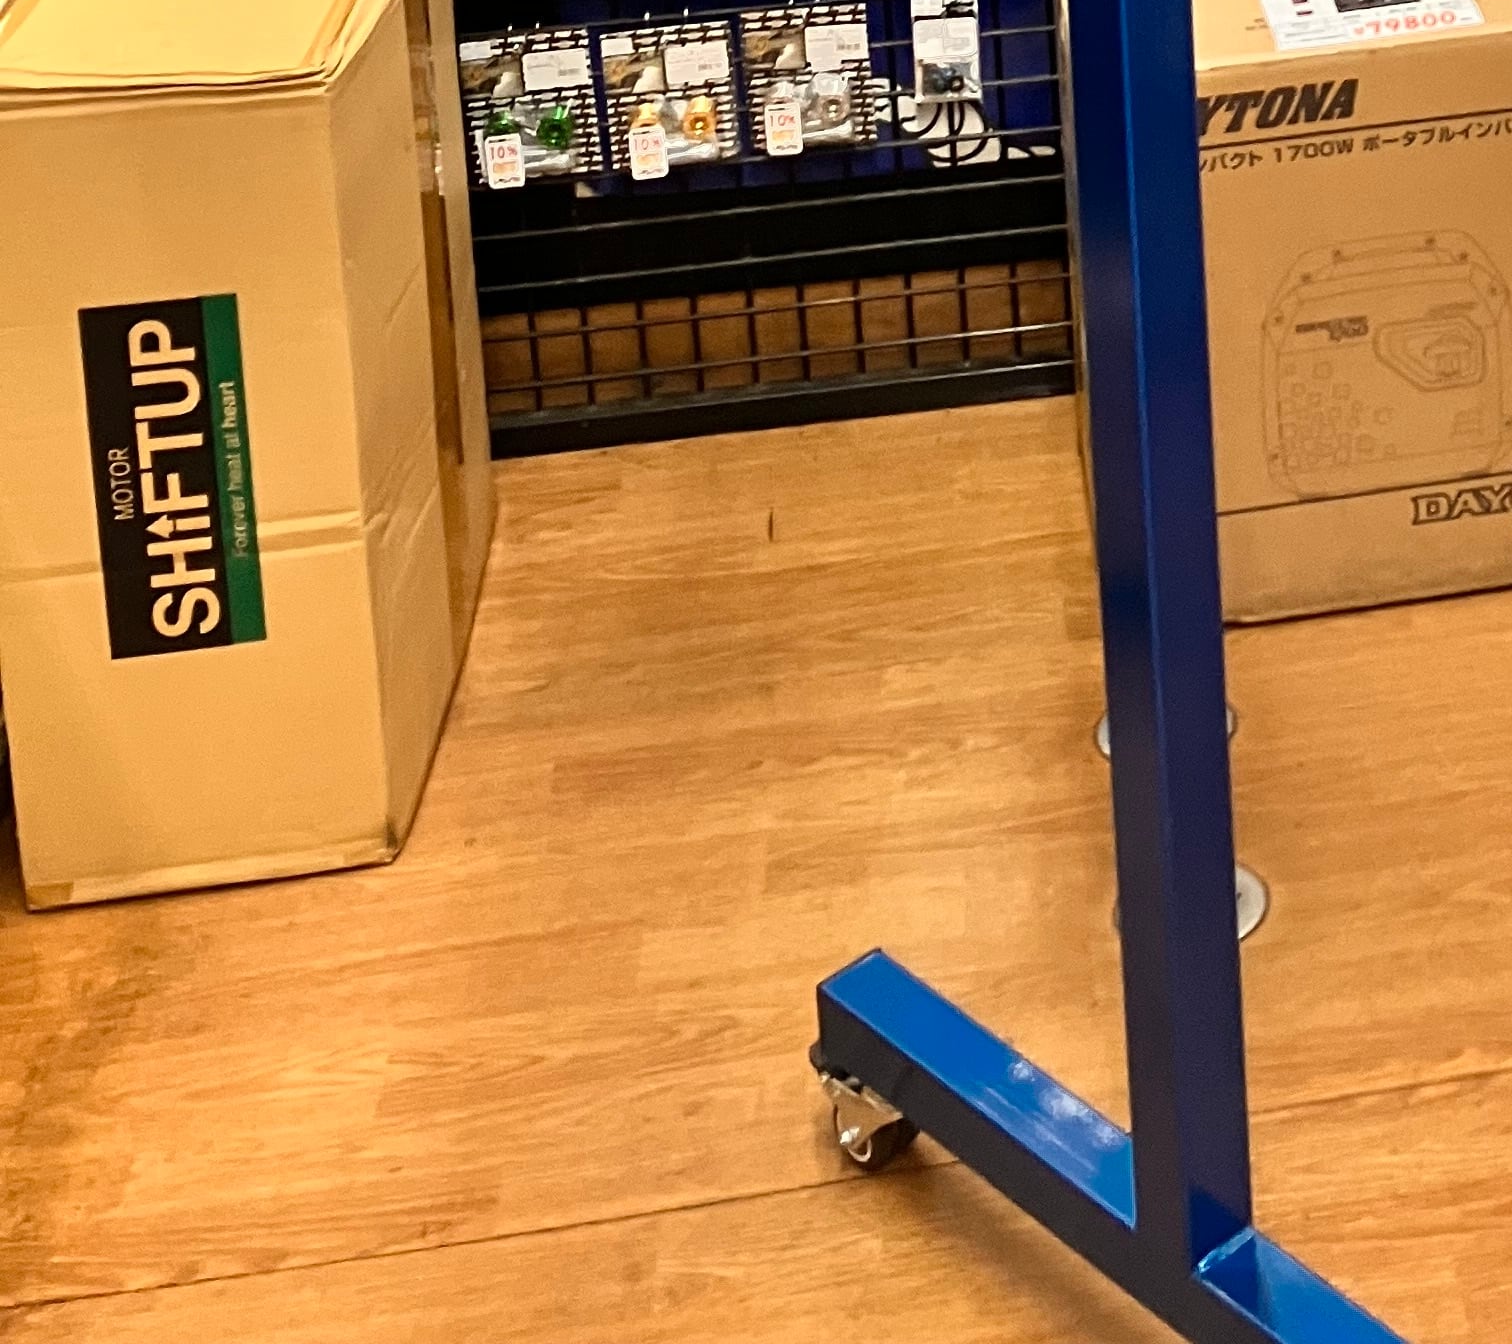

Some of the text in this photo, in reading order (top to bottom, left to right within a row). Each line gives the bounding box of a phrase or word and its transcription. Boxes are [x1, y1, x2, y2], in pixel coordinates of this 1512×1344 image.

[1197, 78, 1360, 136] YTONA
[1273, 137, 1354, 165] 1700W
[107, 446, 136, 520] MOTOR
